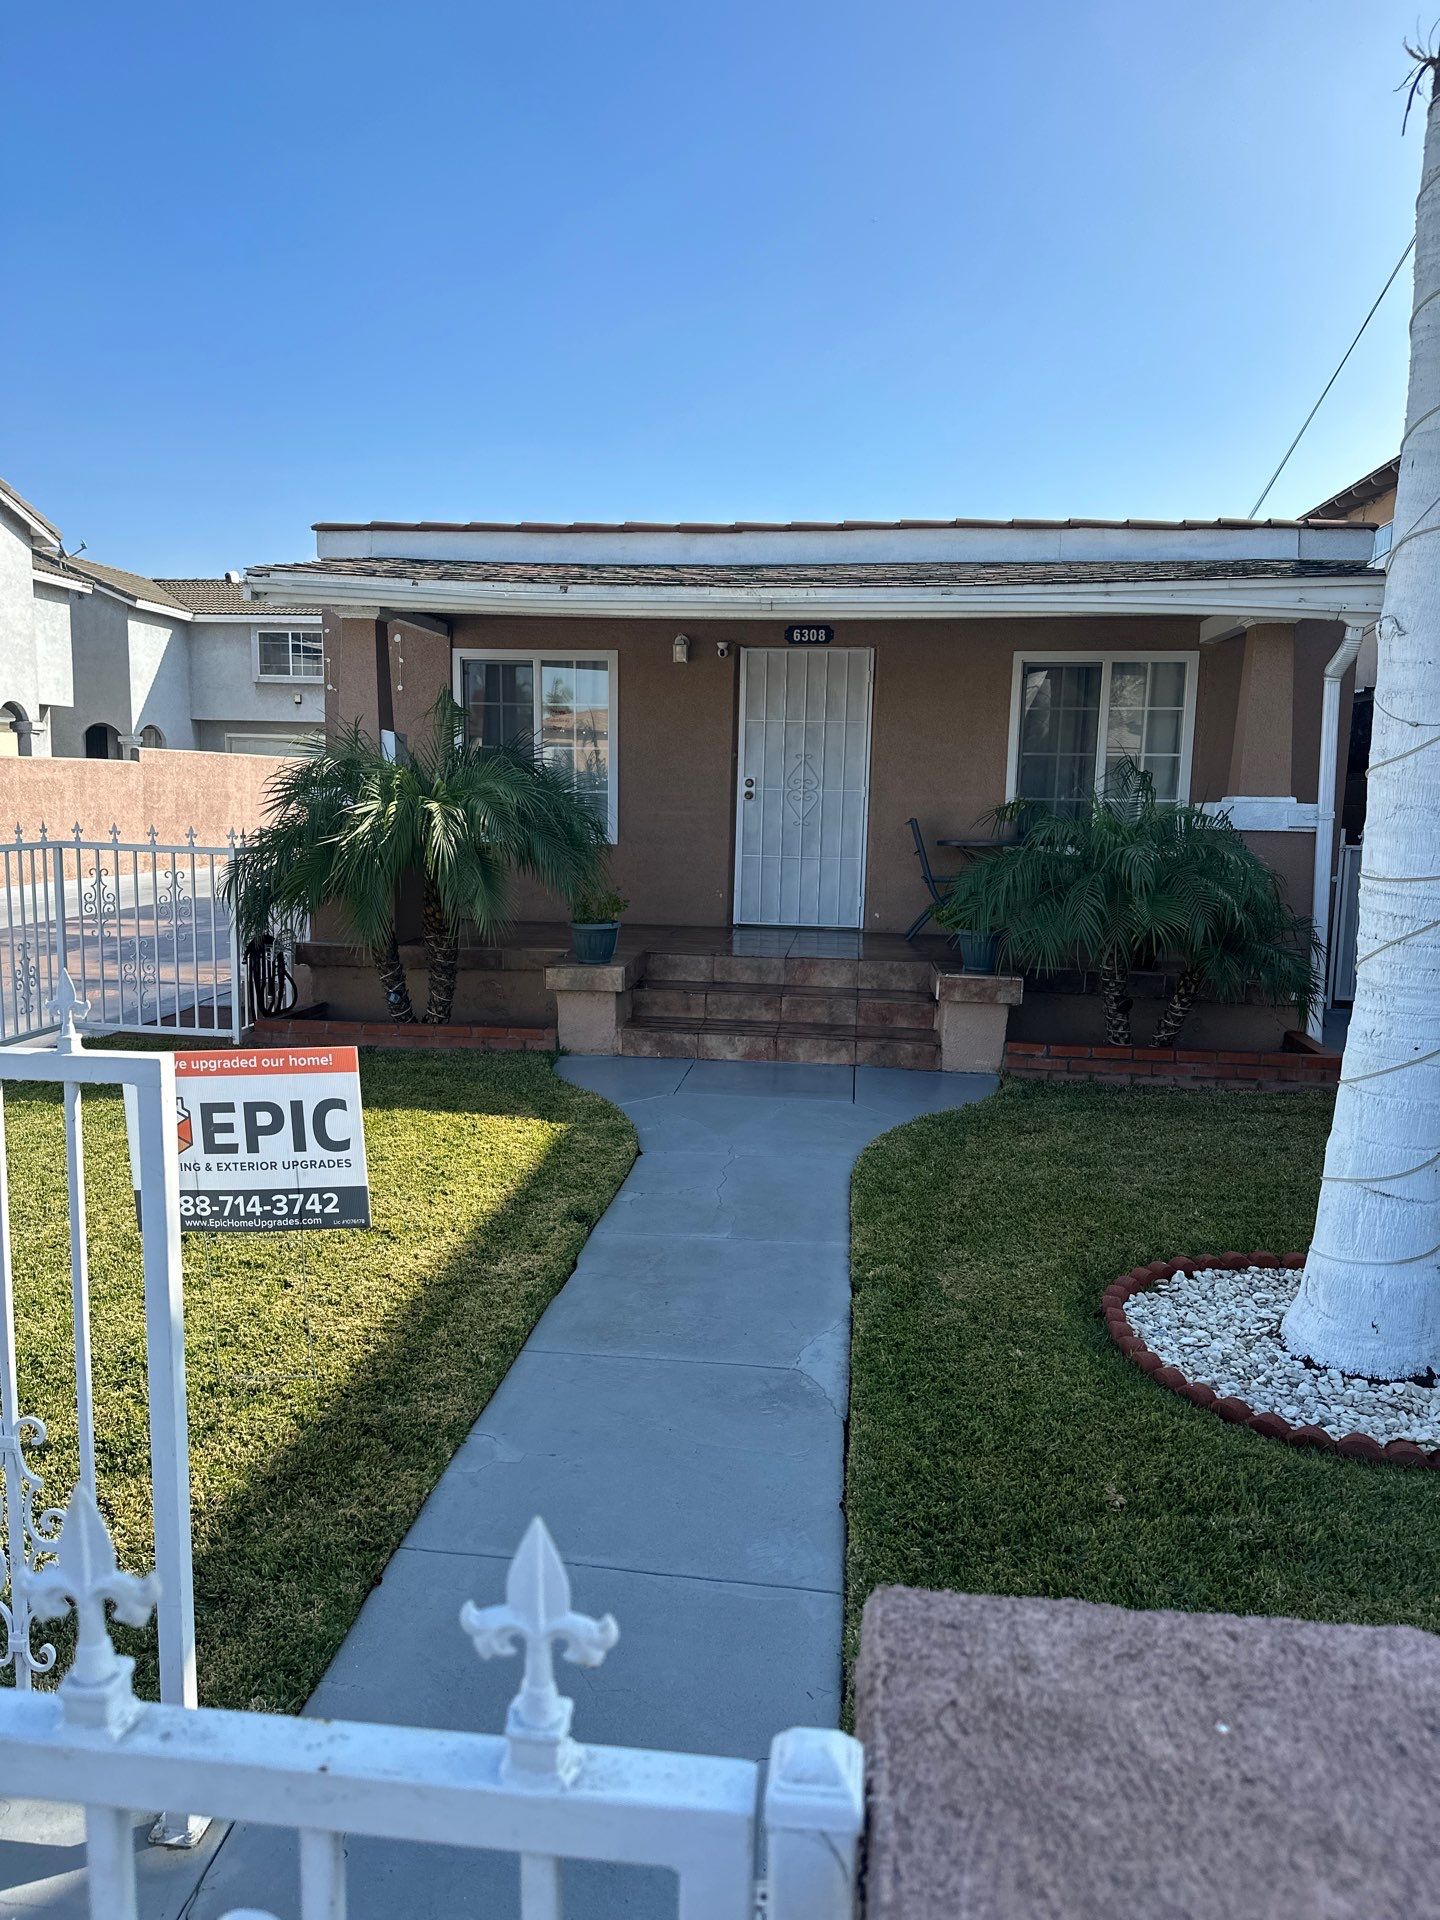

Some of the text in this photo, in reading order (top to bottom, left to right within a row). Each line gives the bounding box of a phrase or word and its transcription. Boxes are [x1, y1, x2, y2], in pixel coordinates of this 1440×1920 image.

[793, 629, 826, 641] 6308
[190, 1056, 257, 1072] upgraded
[261, 1057, 284, 1067] our
[288, 1053, 333, 1067] home!
[199, 1098, 351, 1155] EPIC
[180, 1159, 352, 1172] ING & EXTERIOR UPGRADES
[180, 1192, 340, 1217] 88-714-3742
[185, 1217, 322, 1229] www.EpicHomeUpgrades.com
